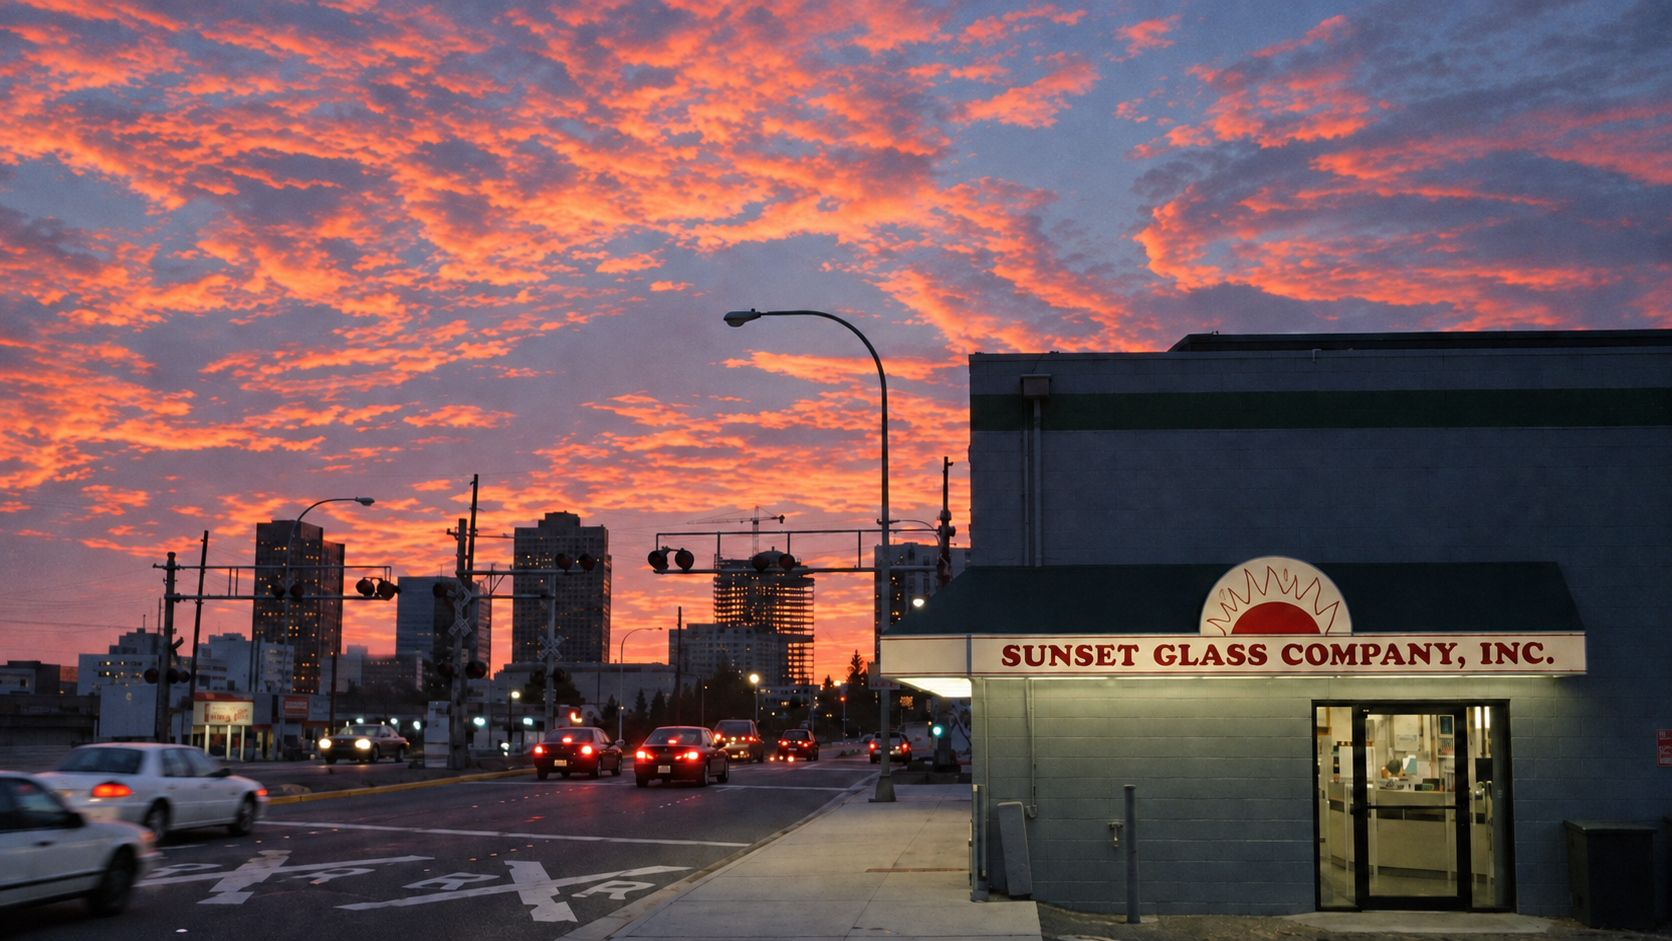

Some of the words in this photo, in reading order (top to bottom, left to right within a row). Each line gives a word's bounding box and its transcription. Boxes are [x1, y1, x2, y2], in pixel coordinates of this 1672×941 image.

[1001, 643, 1139, 667] SUNSET
[1153, 643, 1268, 667] GLASS
[1281, 642, 1466, 669] COMPANY,
[1480, 641, 1555, 665] INC.
[571, 880, 656, 900] R
